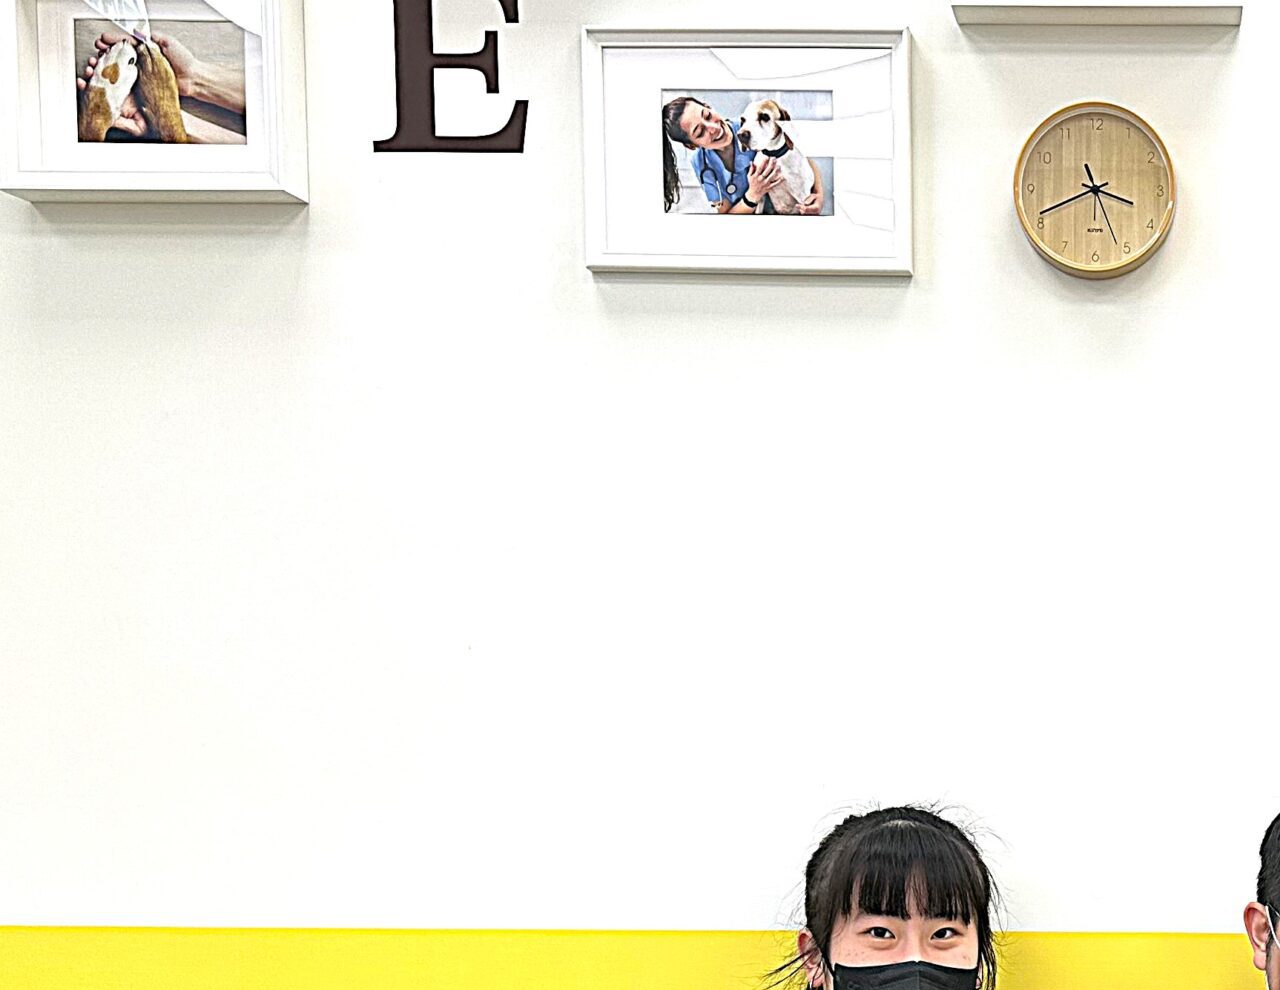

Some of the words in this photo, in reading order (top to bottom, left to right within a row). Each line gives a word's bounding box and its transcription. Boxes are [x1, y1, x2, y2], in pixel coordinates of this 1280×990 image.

[373, 0, 529, 153] E
[1090, 118, 1104, 131] 12
[1059, 127, 1071, 140] 11
[1125, 127, 1132, 139] 1
[1037, 151, 1052, 165] 10
[1147, 151, 1155, 164] 2
[1026, 183, 1035, 194] 9
[1156, 185, 1165, 198] 3
[1036, 217, 1045, 230] 8
[1146, 218, 1154, 230] 4
[1061, 241, 1069, 253] 7
[1122, 242, 1131, 254] 5
[1091, 250, 1100, 263] 6
